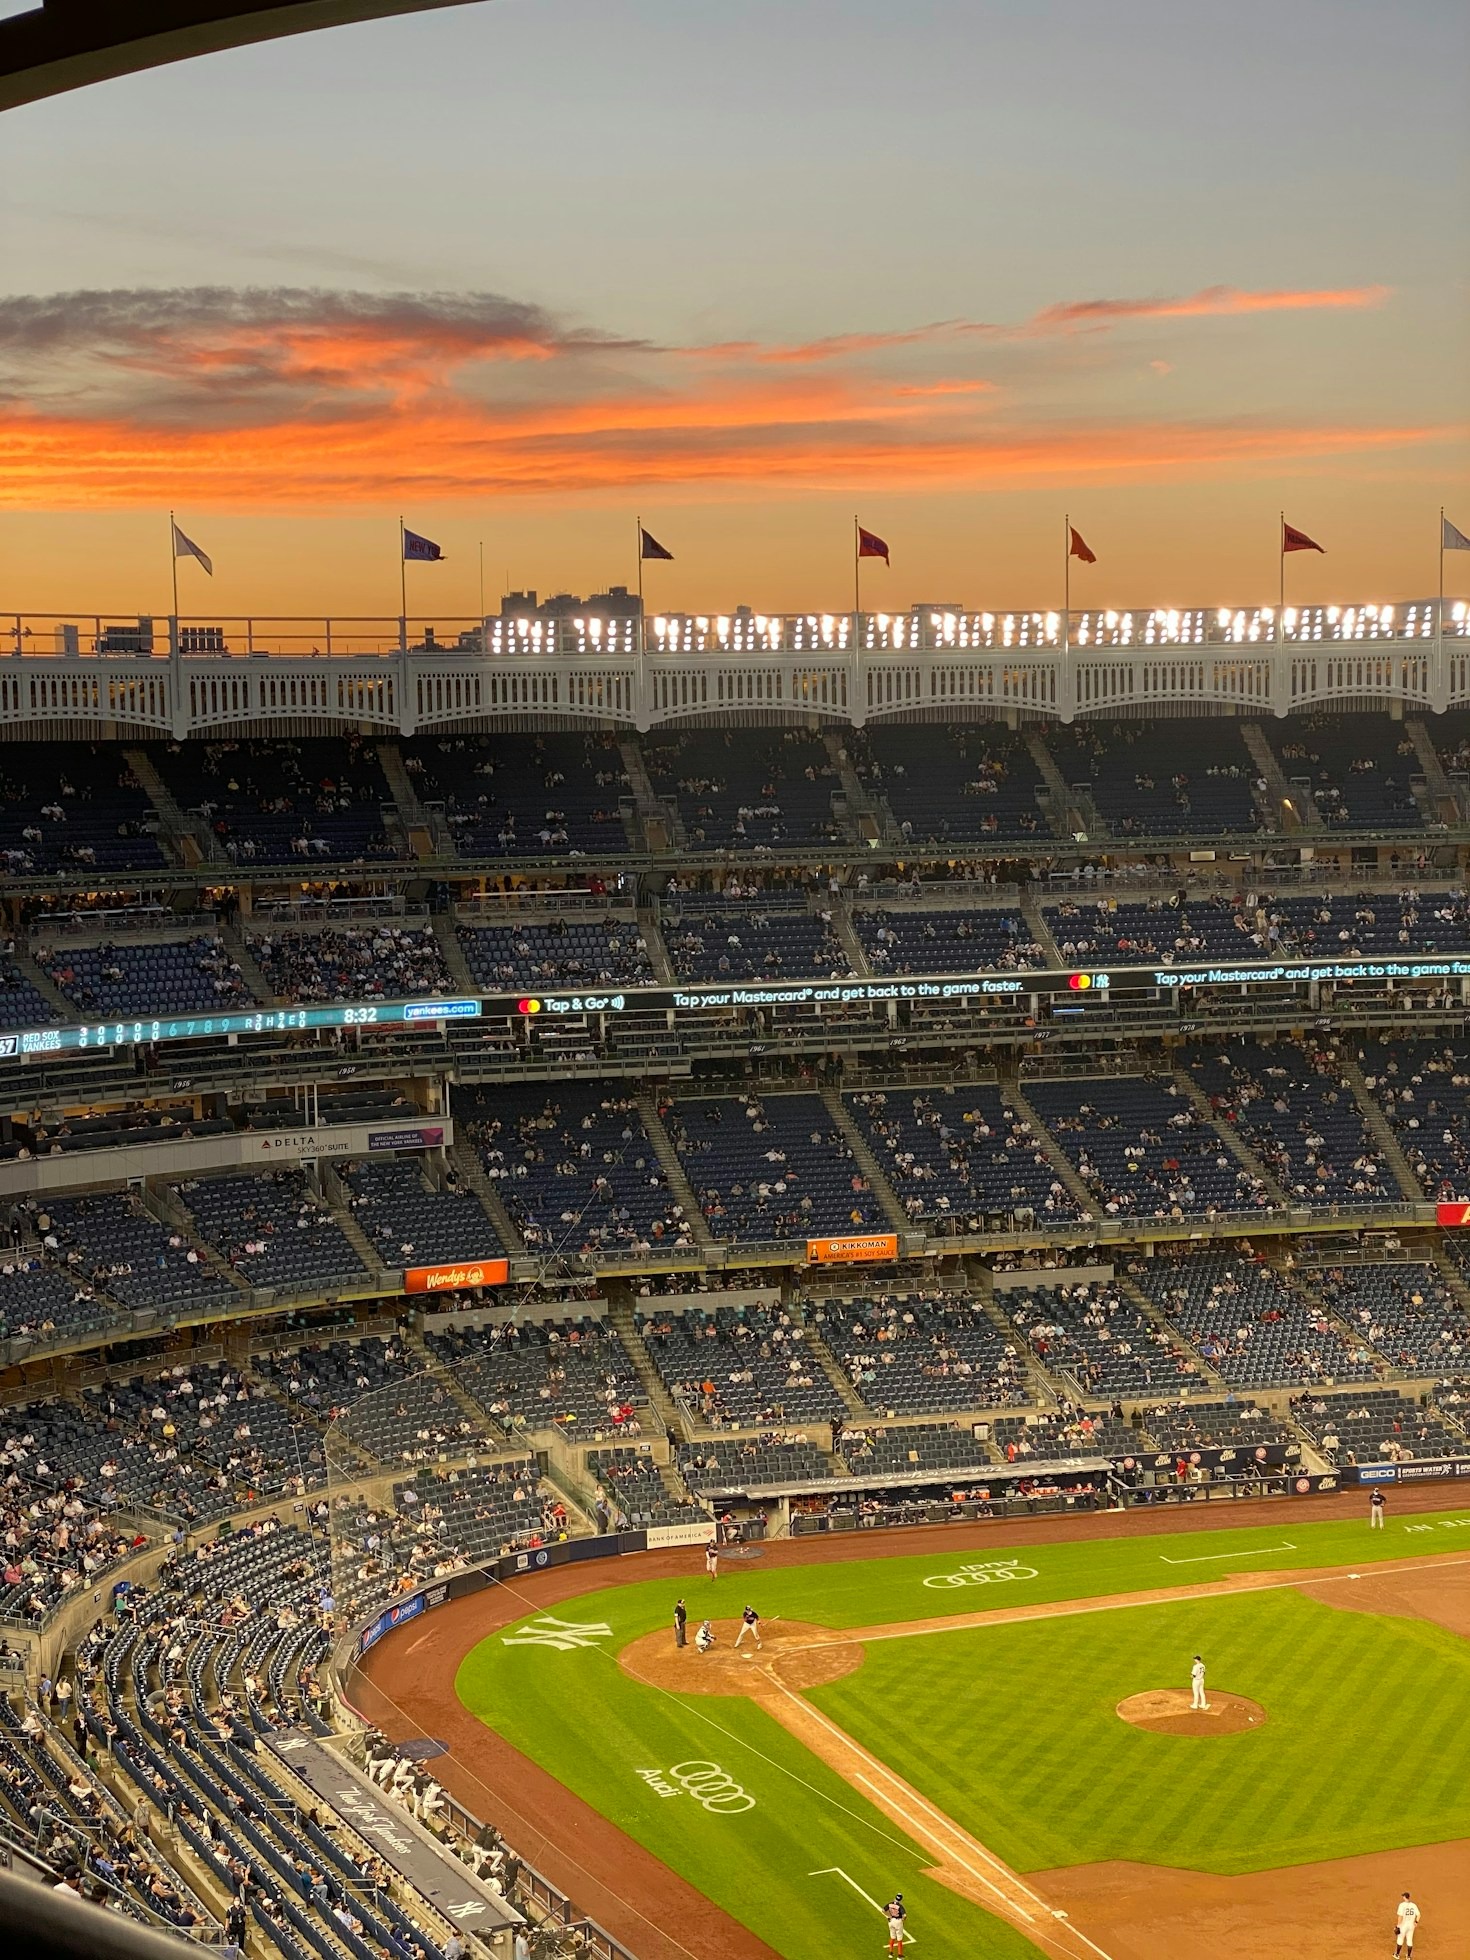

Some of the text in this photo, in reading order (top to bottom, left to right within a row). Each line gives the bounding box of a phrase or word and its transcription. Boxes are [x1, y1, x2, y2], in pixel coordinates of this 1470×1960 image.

[1155, 972, 1178, 986] Tap
[1179, 972, 1207, 985] your
[1286, 966, 1310, 979] and
[1311, 966, 1333, 980] get
[1335, 964, 1367, 977] back
[1369, 964, 1384, 975] to
[1387, 963, 1409, 975] the
[1411, 963, 1450, 977] game
[673, 993, 699, 1007] Tap
[701, 994, 730, 1007] your
[814, 987, 839, 1000] and
[842, 987, 865, 1001] get
[868, 985, 898, 997] back
[901, 985, 915, 996] to
[918, 983, 940, 995] the
[943, 982, 979, 996] game
[982, 980, 1024, 993] faster.
[407, 1002, 475, 1018] yankees.com
[544, 998, 570, 1013] Tap
[572, 998, 583, 1010] &
[266, 1017, 273, 1026] H
[289, 1015, 295, 1025] E
[344, 1008, 377, 1023] 8:32
[169, 1019, 230, 1036] 6 7 8 9
[245, 1019, 252, 1028] R
[23, 1021, 159, 1043] RED SOX 3 0 0 0 0
[23, 1031, 159, 1052] YANKEES 0 0 0 0 0
[275, 1137, 315, 1147] DELTA
[842, 1241, 887, 1250] KIKKOMAN
[823, 1251, 854, 1259] AMERICA'S
[426, 1268, 466, 1289] Wendy's
[1361, 1469, 1396, 1478] GEICO
[674, 1532, 702, 1540] AMERICA
[960, 1559, 1019, 1571] Audi
[401, 1599, 418, 1619] pepsi
[635, 1769, 683, 1798] Audi
[336, 1786, 413, 1854] New York Yankees
[1405, 1908, 1415, 1916] 26
